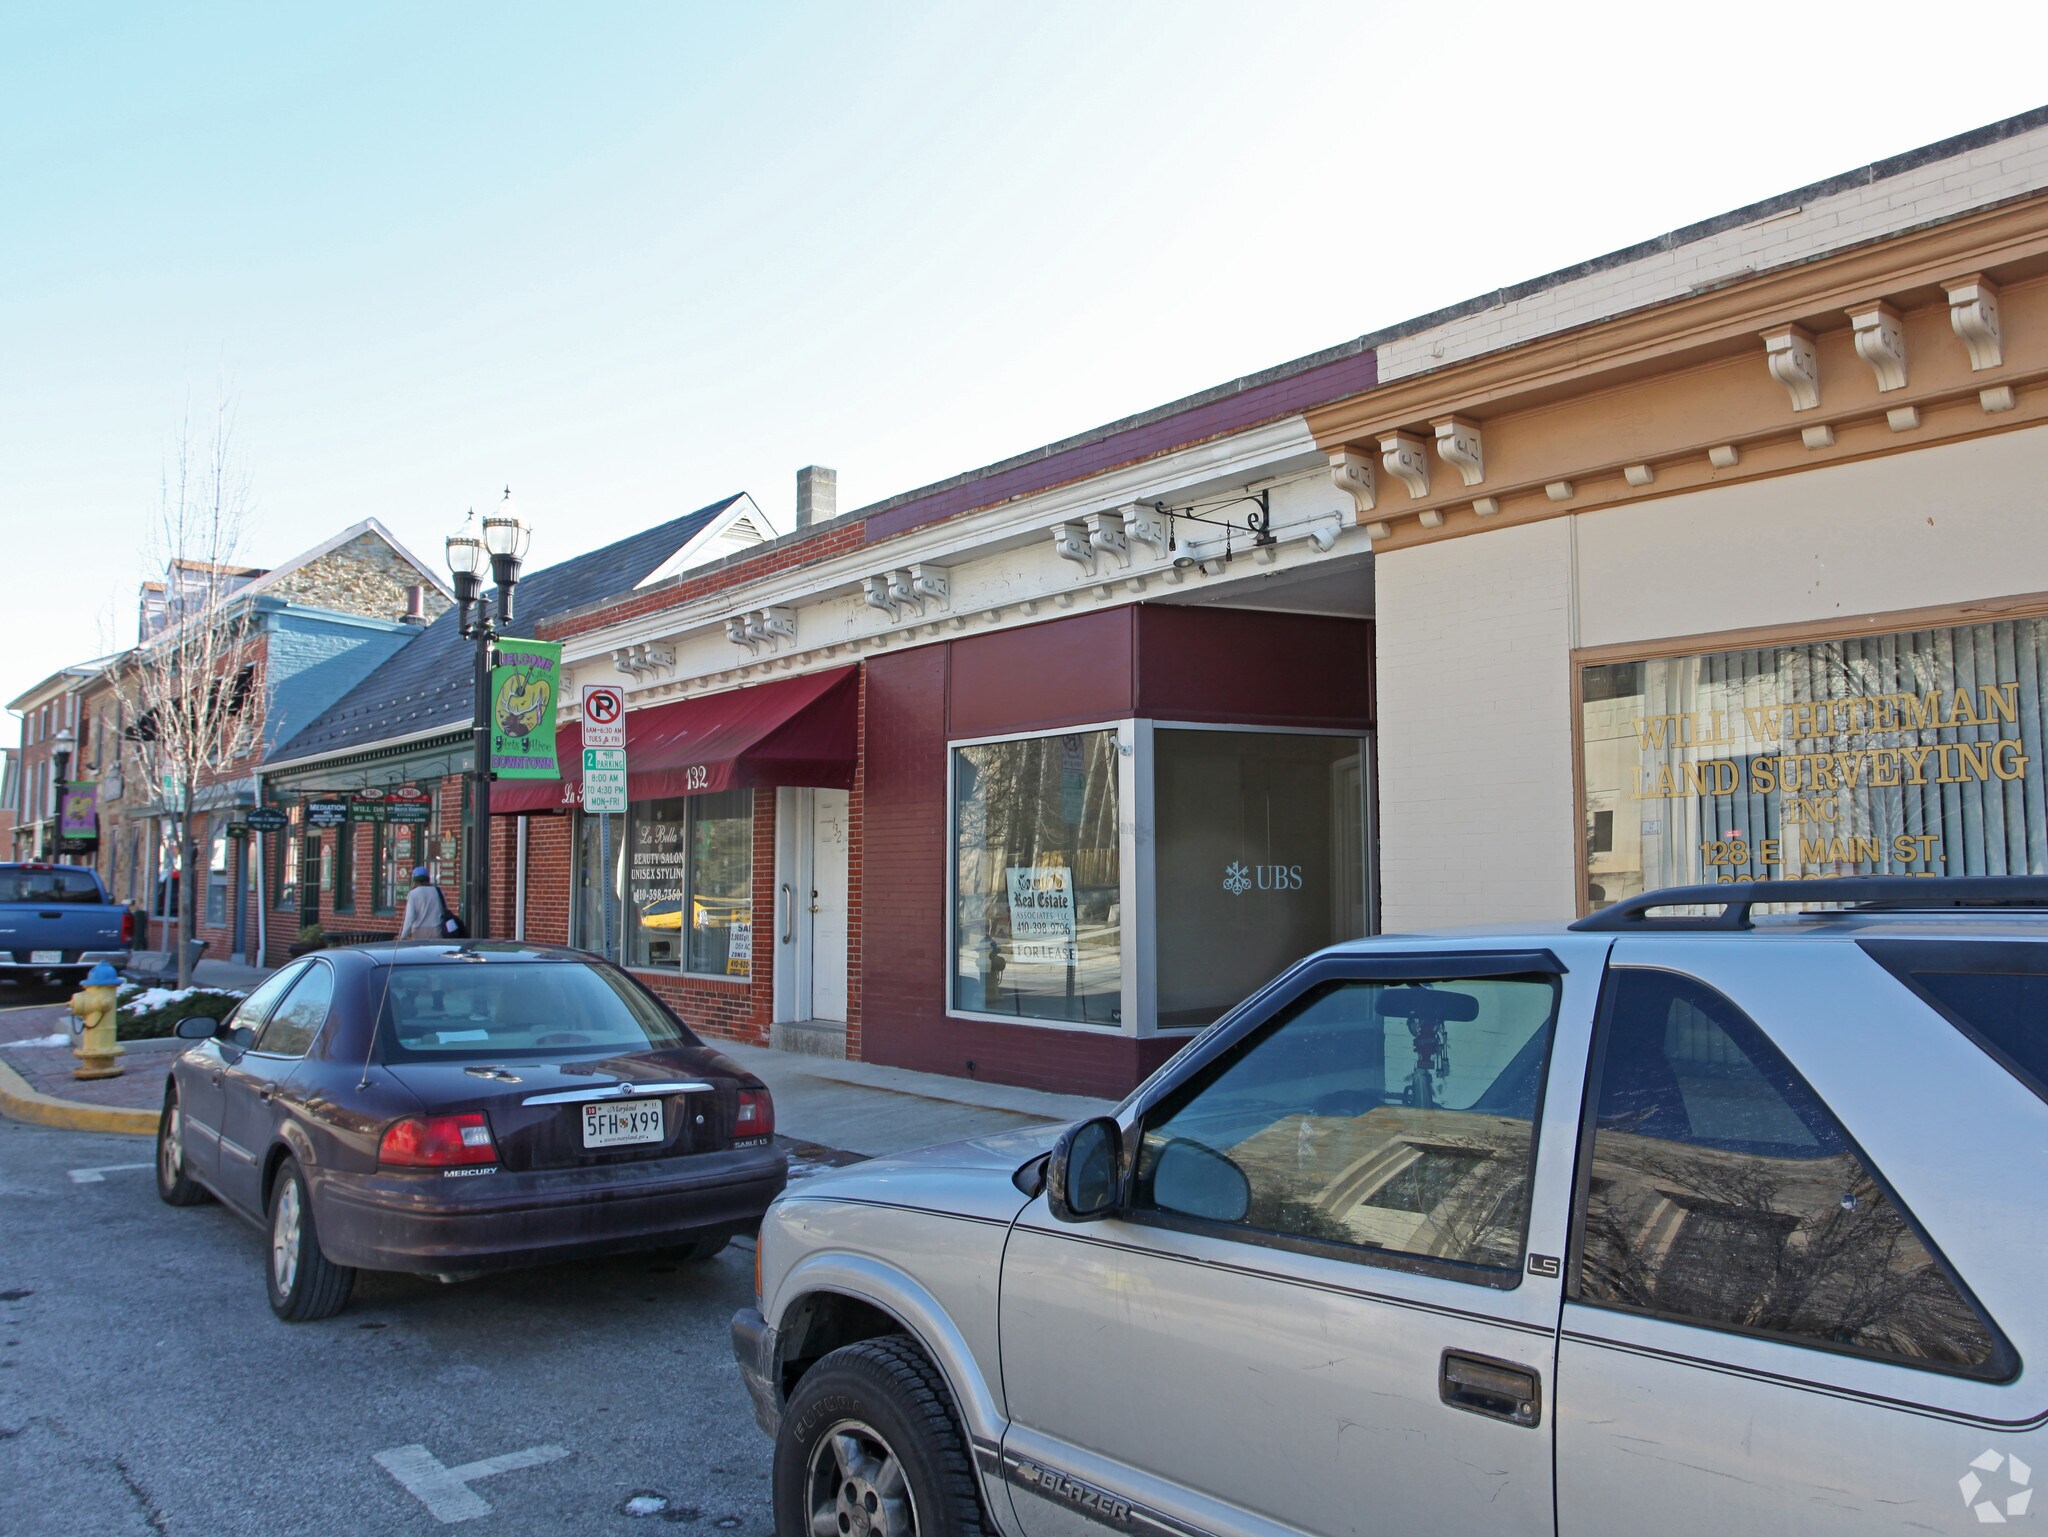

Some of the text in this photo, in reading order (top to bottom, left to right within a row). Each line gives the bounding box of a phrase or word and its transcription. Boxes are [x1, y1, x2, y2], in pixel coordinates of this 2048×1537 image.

[500, 652, 554, 672] WELCOME
[1631, 682, 2019, 750] WILL WHITEMAN
[614, 726, 622, 734] AM
[588, 735, 602, 743] TUES
[611, 735, 620, 743] FRI
[492, 755, 554, 769] DOWNTOWN
[587, 753, 594, 766] 2
[596, 760, 623, 768] PARKING
[1629, 738, 2030, 799] LAND SURVEYING
[591, 774, 618, 782] 8:00 AM
[685, 765, 708, 790] 132
[597, 786, 612, 794] 4:30
[614, 787, 624, 795] PM
[591, 797, 620, 806] MON-FRI
[1786, 797, 1845, 824] INC.
[640, 824, 678, 844] La Bella
[1699, 834, 1947, 865] 128 E. MAIN ST.
[633, 852, 684, 865] BEAUTY SALON
[631, 868, 656, 880] UNISEX
[1255, 865, 1303, 890] UBS
[1014, 890, 1068, 909] Real Estate
[1016, 911, 1069, 920] ASSOCIATES LLC
[1017, 944, 1074, 960] FOR LEASE
[607, 1104, 638, 1113] Maryland
[587, 1111, 659, 1136] 5FH X99
[443, 1167, 498, 1178] MERCURY
[1529, 1256, 1558, 1275] LS
[1040, 1470, 1129, 1521] BLAZER
